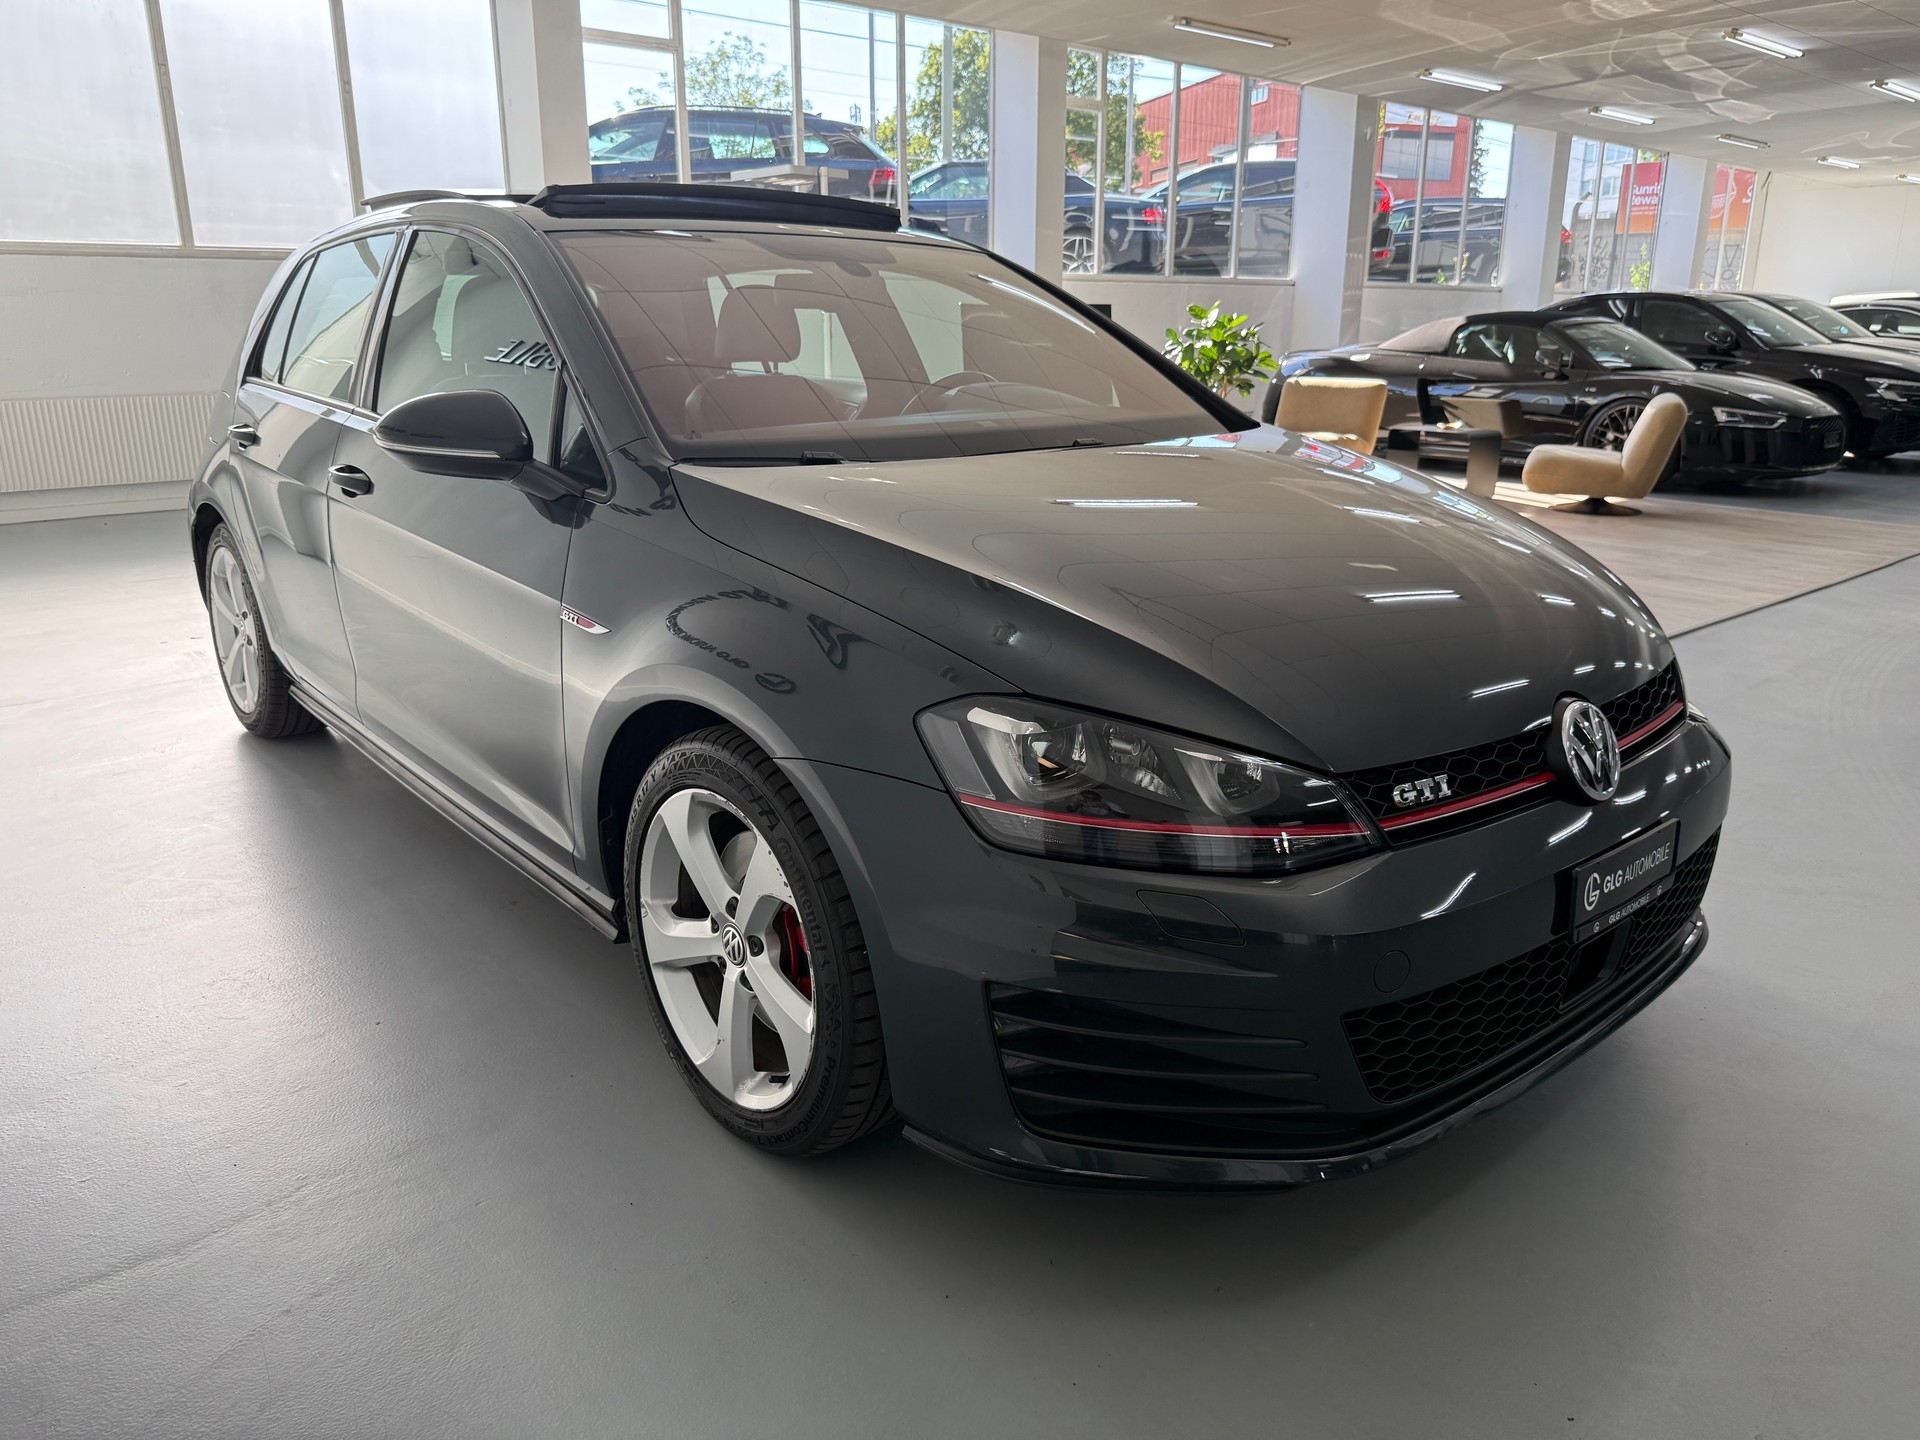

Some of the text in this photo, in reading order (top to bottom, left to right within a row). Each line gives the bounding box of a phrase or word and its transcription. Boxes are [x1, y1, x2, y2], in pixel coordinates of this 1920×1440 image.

[562, 610, 578, 625] GTI
[1393, 774, 1451, 807] GTI
[1603, 842, 1670, 893] GLG AUTOMOBILE
[776, 837, 828, 951] Continental
[1609, 911, 1621, 924] GLG
[1621, 893, 1650, 918] AUTOMOBILE
[766, 1055, 837, 1145] PremiumContact
